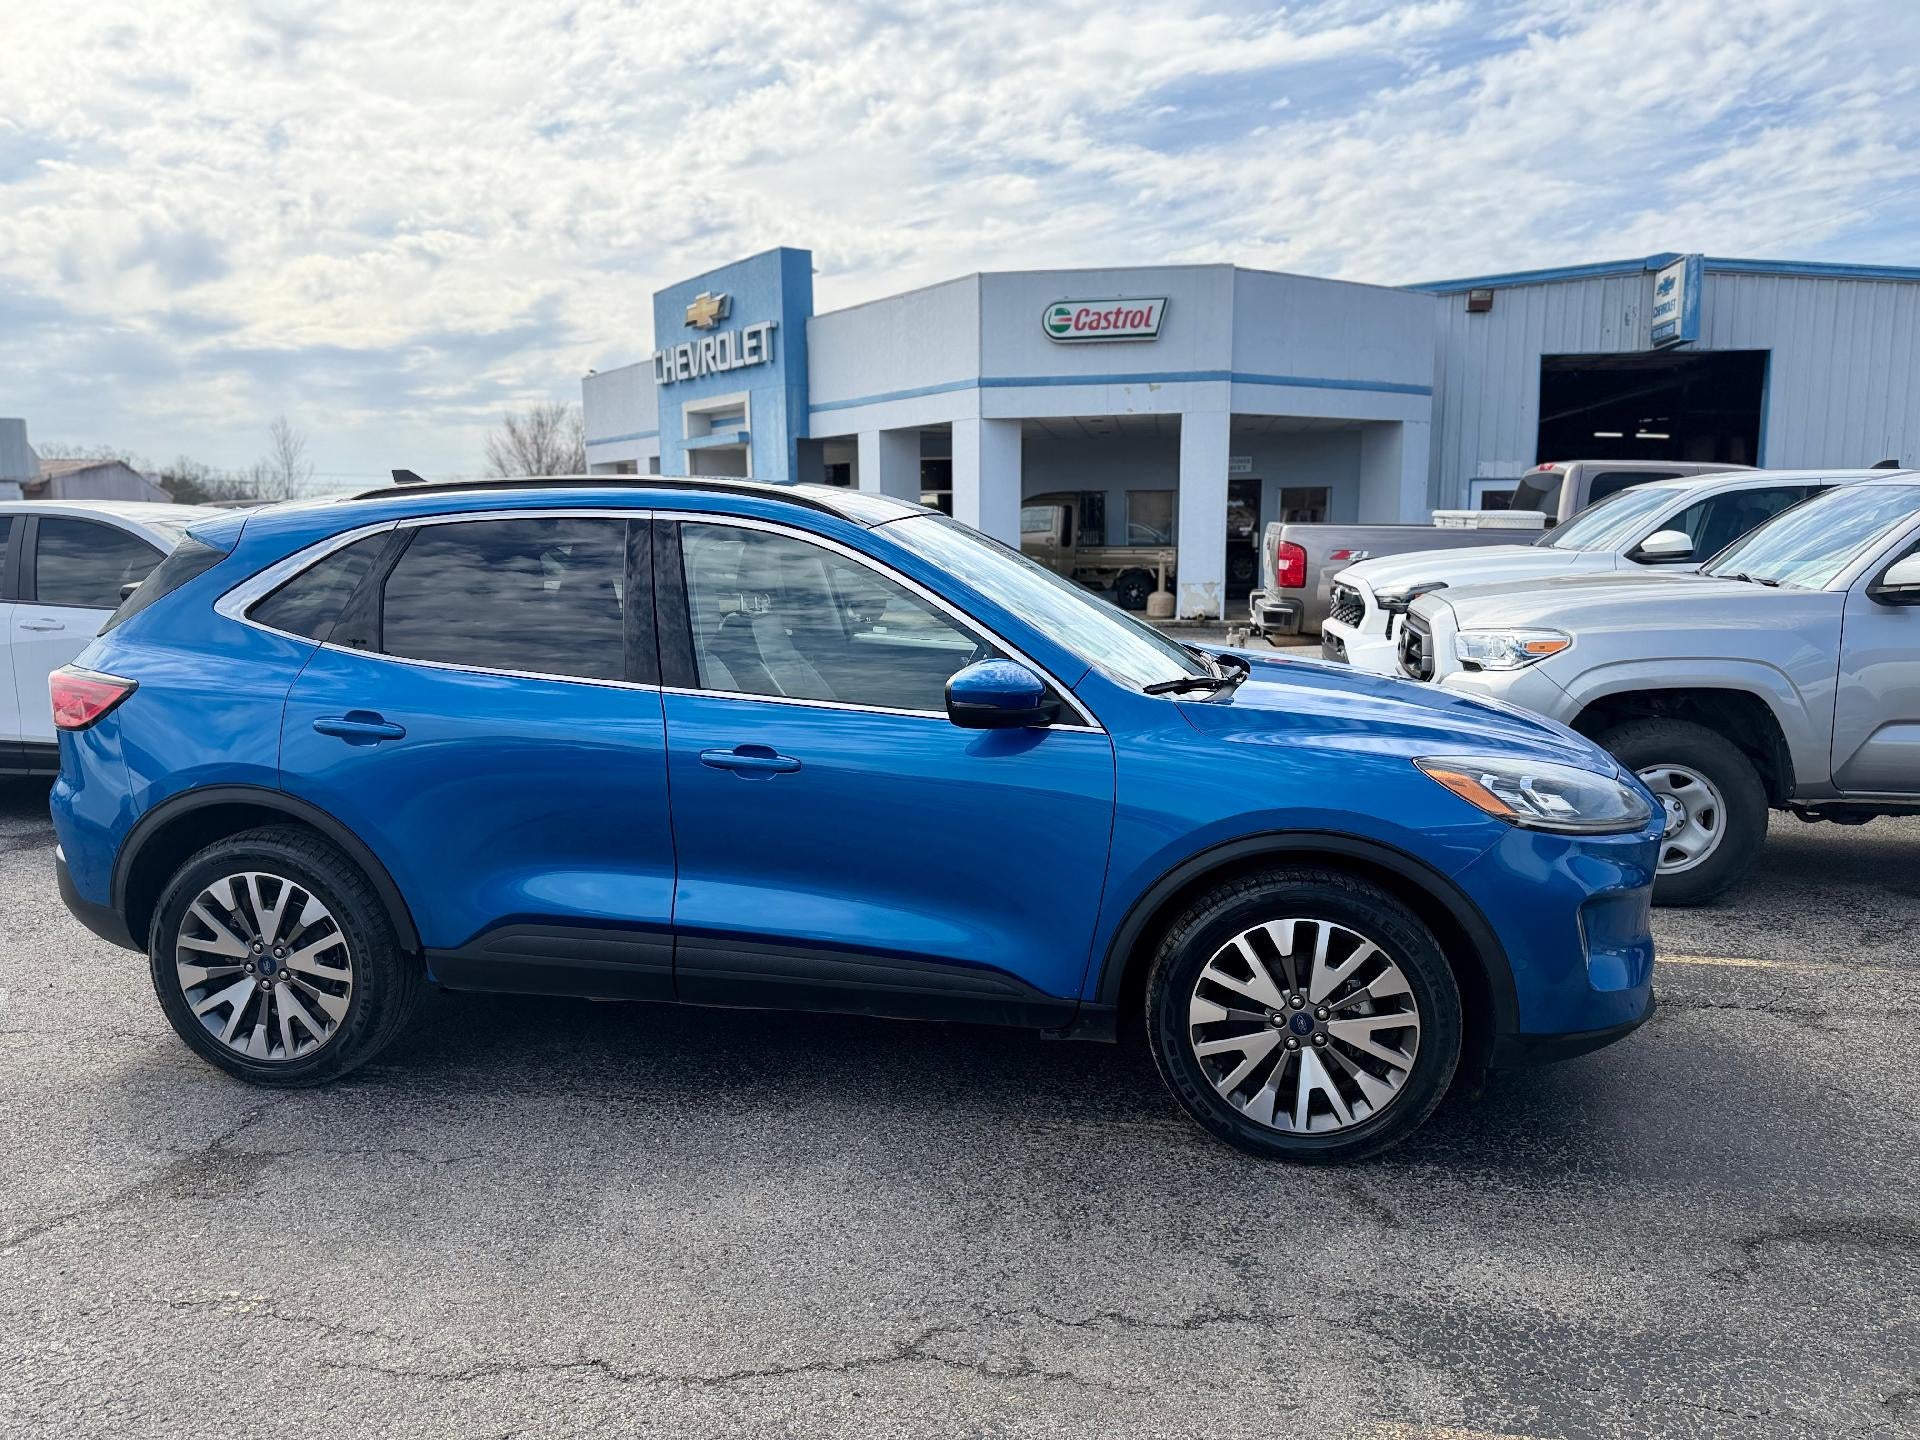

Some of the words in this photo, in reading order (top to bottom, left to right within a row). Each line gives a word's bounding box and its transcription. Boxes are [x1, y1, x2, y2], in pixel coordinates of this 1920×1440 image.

[1073, 305, 1153, 332] Castrol
[652, 320, 773, 385] CHEVROLET
[1329, 549, 1369, 562] Z71
